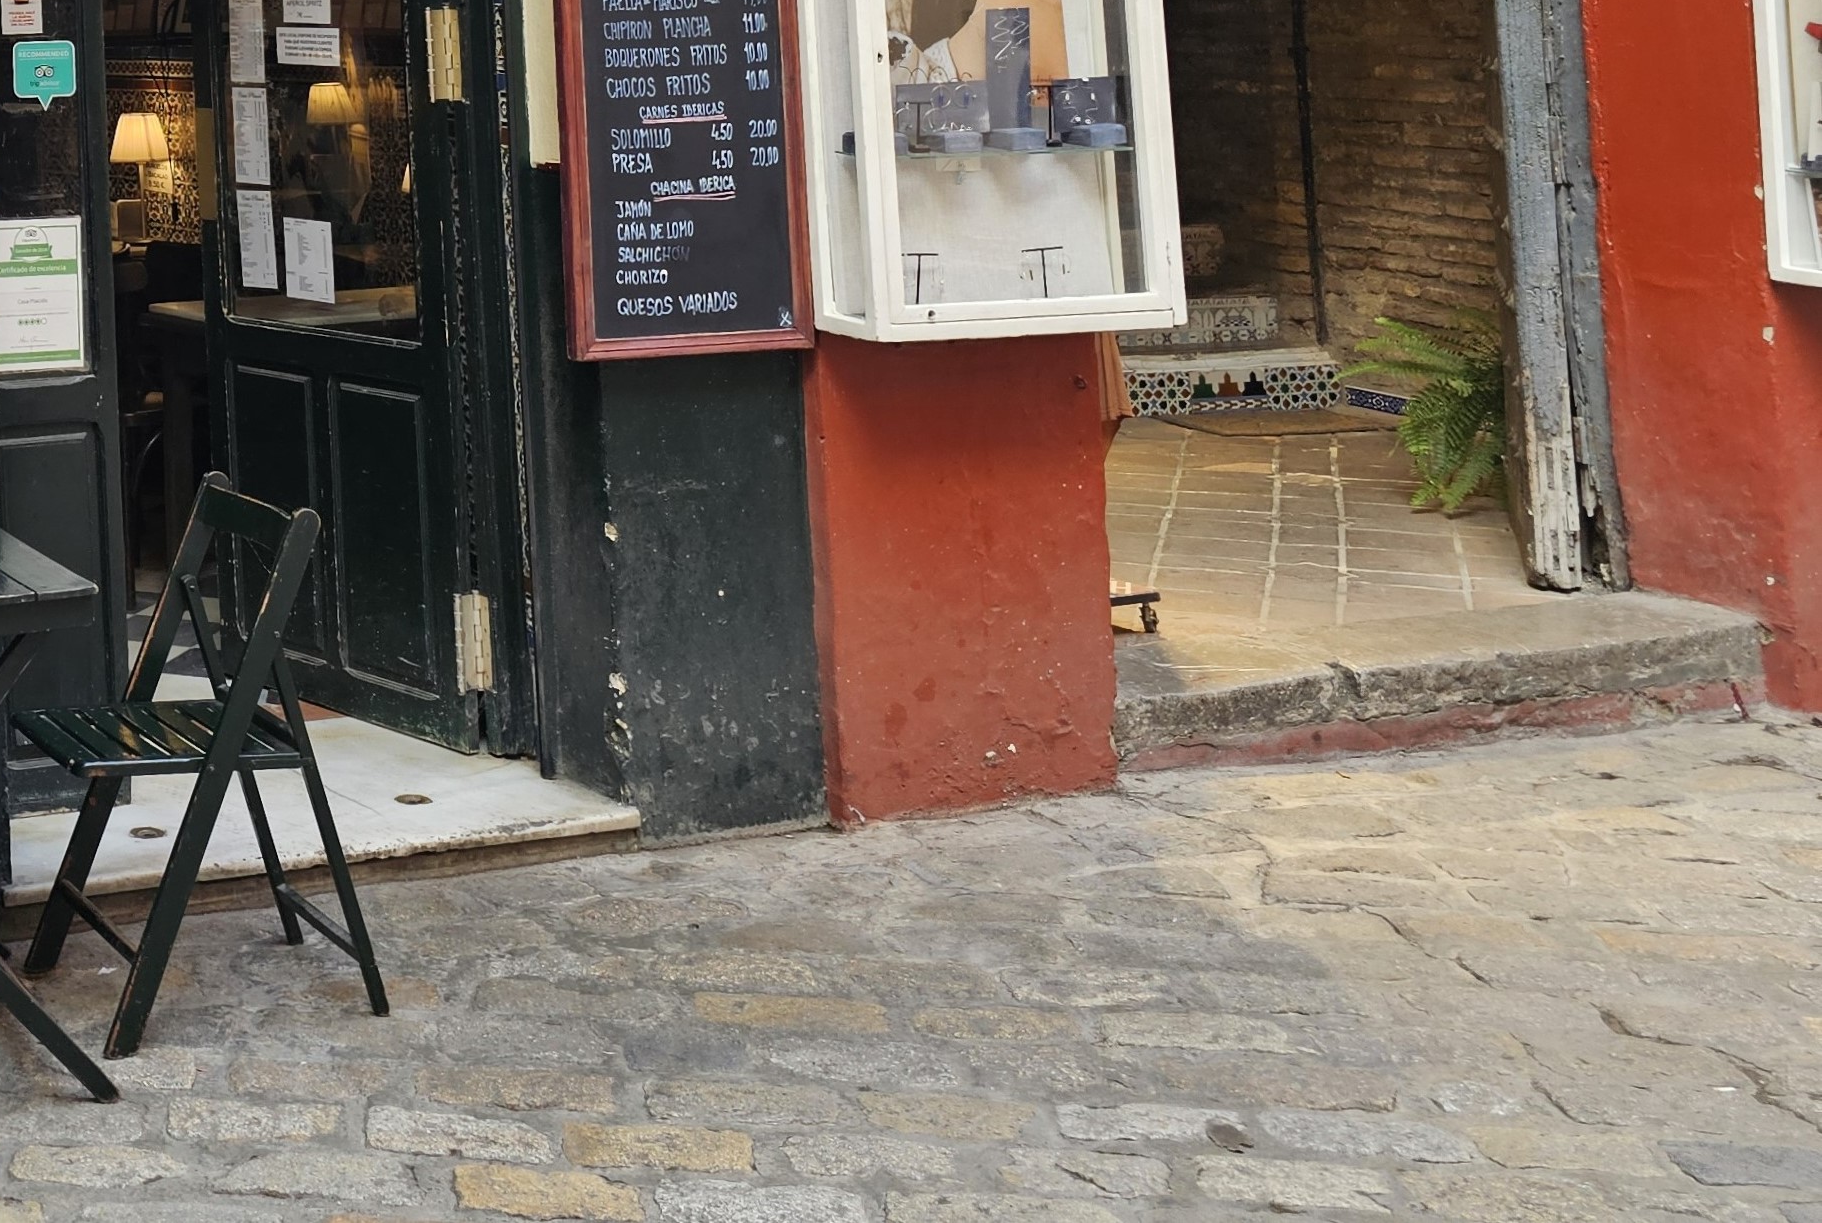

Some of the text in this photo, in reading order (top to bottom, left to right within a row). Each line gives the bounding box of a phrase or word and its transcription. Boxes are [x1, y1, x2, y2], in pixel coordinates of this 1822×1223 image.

[603, 20, 652, 40] CHIPIRON
[663, 16, 711, 39] PLANCHA
[18, 50, 69, 58] RECOMMENDED
[605, 42, 768, 68] BOQUERONES FRITOS 10.00
[606, 69, 770, 98] CHOCOS FRITOS 10.00
[639, 101, 725, 119] CARNES IBERICAS
[611, 128, 671, 150] SOLOMILLO
[748, 119, 778, 138] 20.00
[612, 152, 654, 174] PRESA
[750, 147, 779, 167] 20.00
[650, 175, 736, 196] CHACINA IBERICA
[615, 200, 651, 219] JAMÓN
[617, 220, 694, 241] CAÑA DE LOMO
[616, 269, 668, 286] CHORIZO
[617, 291, 738, 316] QUESOS VARIADOS
